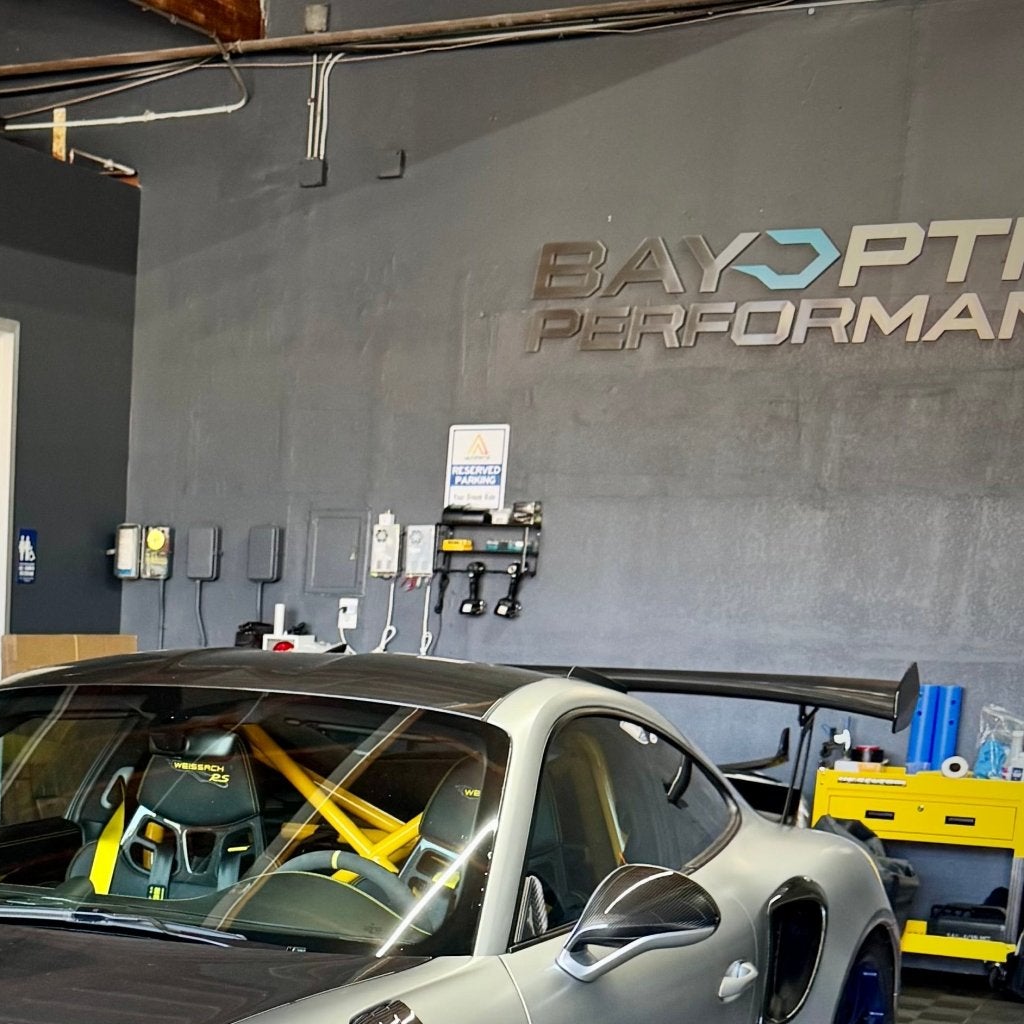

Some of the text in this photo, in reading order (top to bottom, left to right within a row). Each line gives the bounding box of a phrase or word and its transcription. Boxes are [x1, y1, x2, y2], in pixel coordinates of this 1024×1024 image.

[531, 231, 762, 300] BAY
[452, 465, 502, 476] RESERVED
[454, 475, 497, 486] PARKING
[173, 761, 225, 772] WEISSACH
[208, 773, 230, 783] RS
